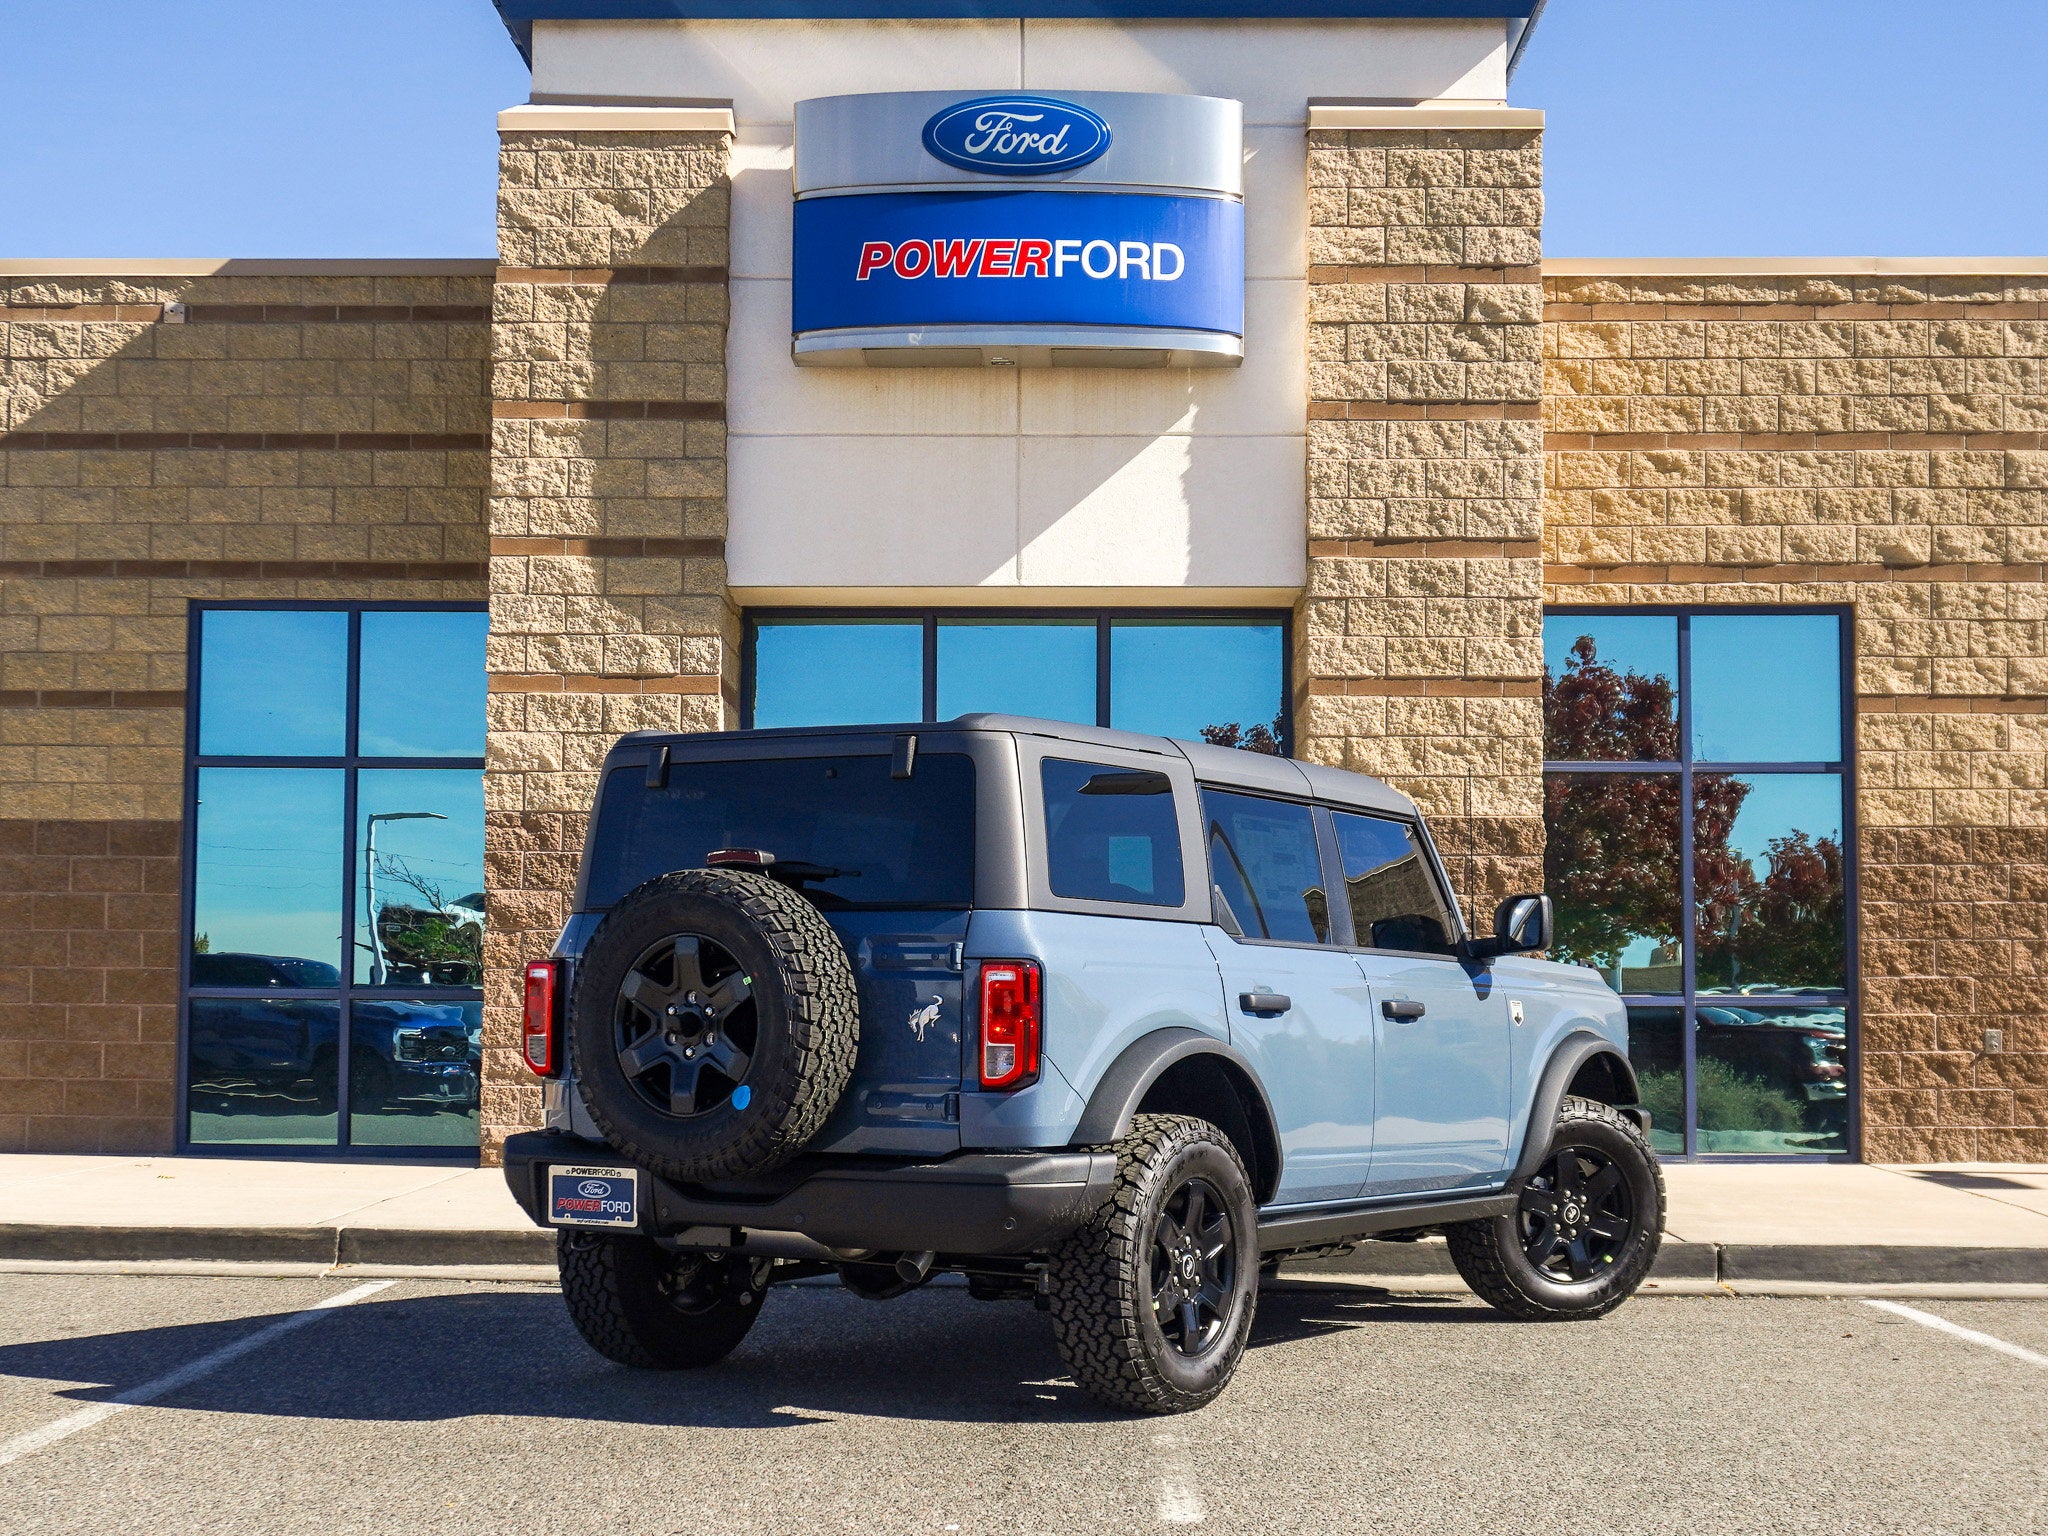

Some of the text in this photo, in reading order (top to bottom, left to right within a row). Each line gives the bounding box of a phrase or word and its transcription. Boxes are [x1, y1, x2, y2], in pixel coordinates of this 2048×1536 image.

[964, 111, 1071, 155] Ford
[856, 239, 1185, 281] POWERFORD
[571, 1167, 616, 1177] POWERFORD
[584, 1182, 605, 1195] Ford
[557, 1197, 631, 1213] POWERFORD
